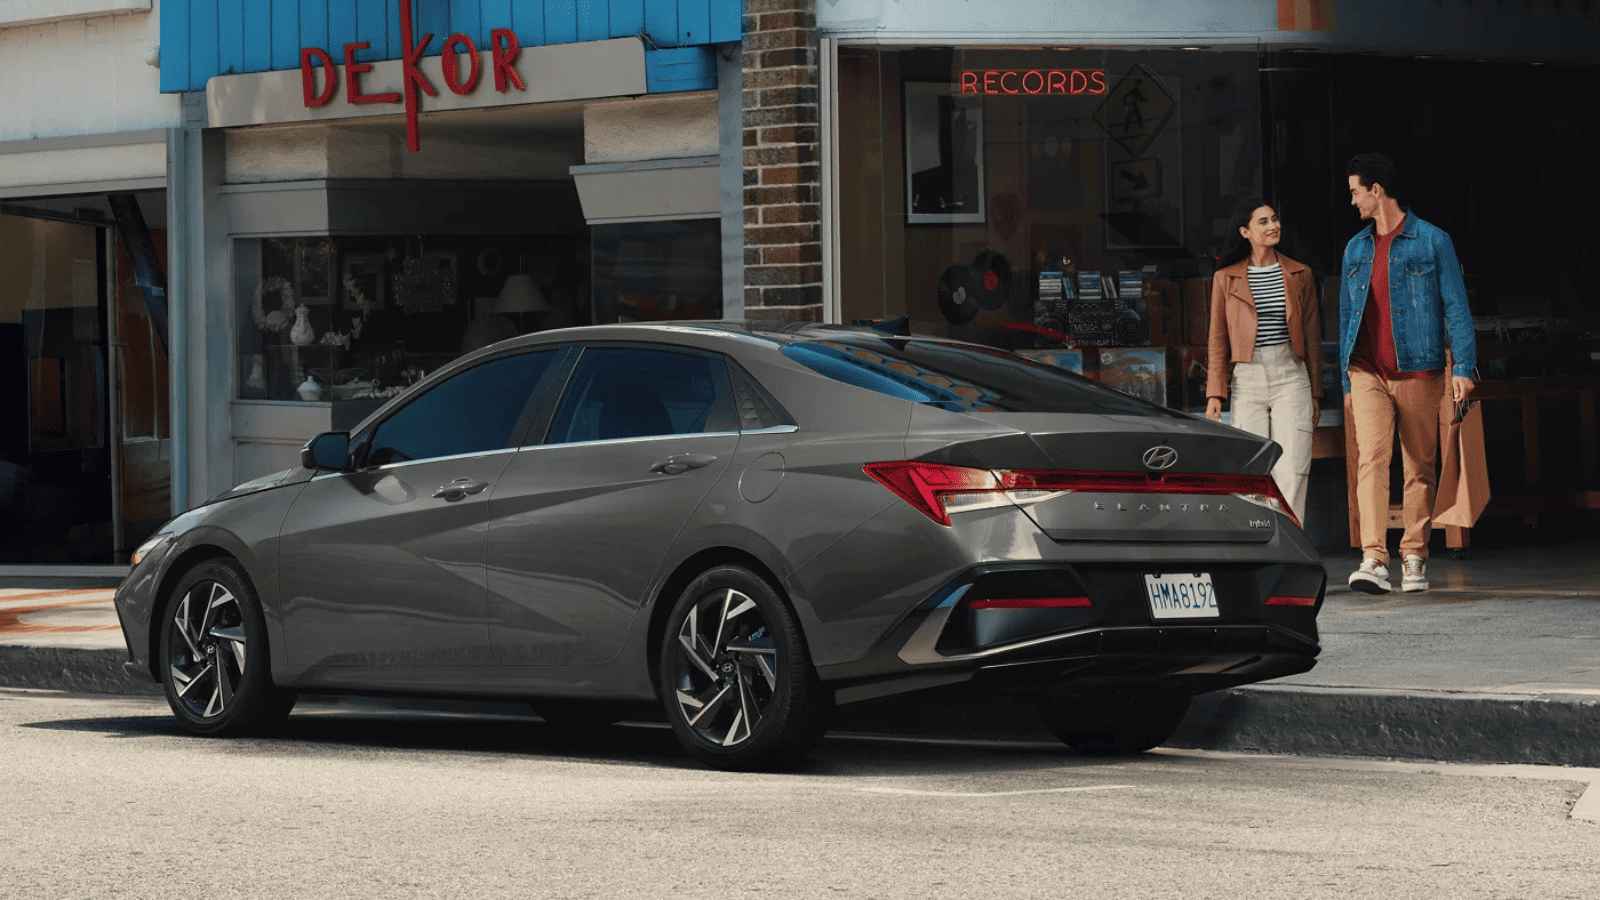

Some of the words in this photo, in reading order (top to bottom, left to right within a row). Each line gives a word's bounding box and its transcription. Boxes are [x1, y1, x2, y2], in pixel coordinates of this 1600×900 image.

[301, 0, 526, 152] DEKOR
[961, 69, 1106, 95] RECORDS
[1094, 501, 1229, 513] ELANTRA
[1149, 582, 1219, 610] HMA8192
